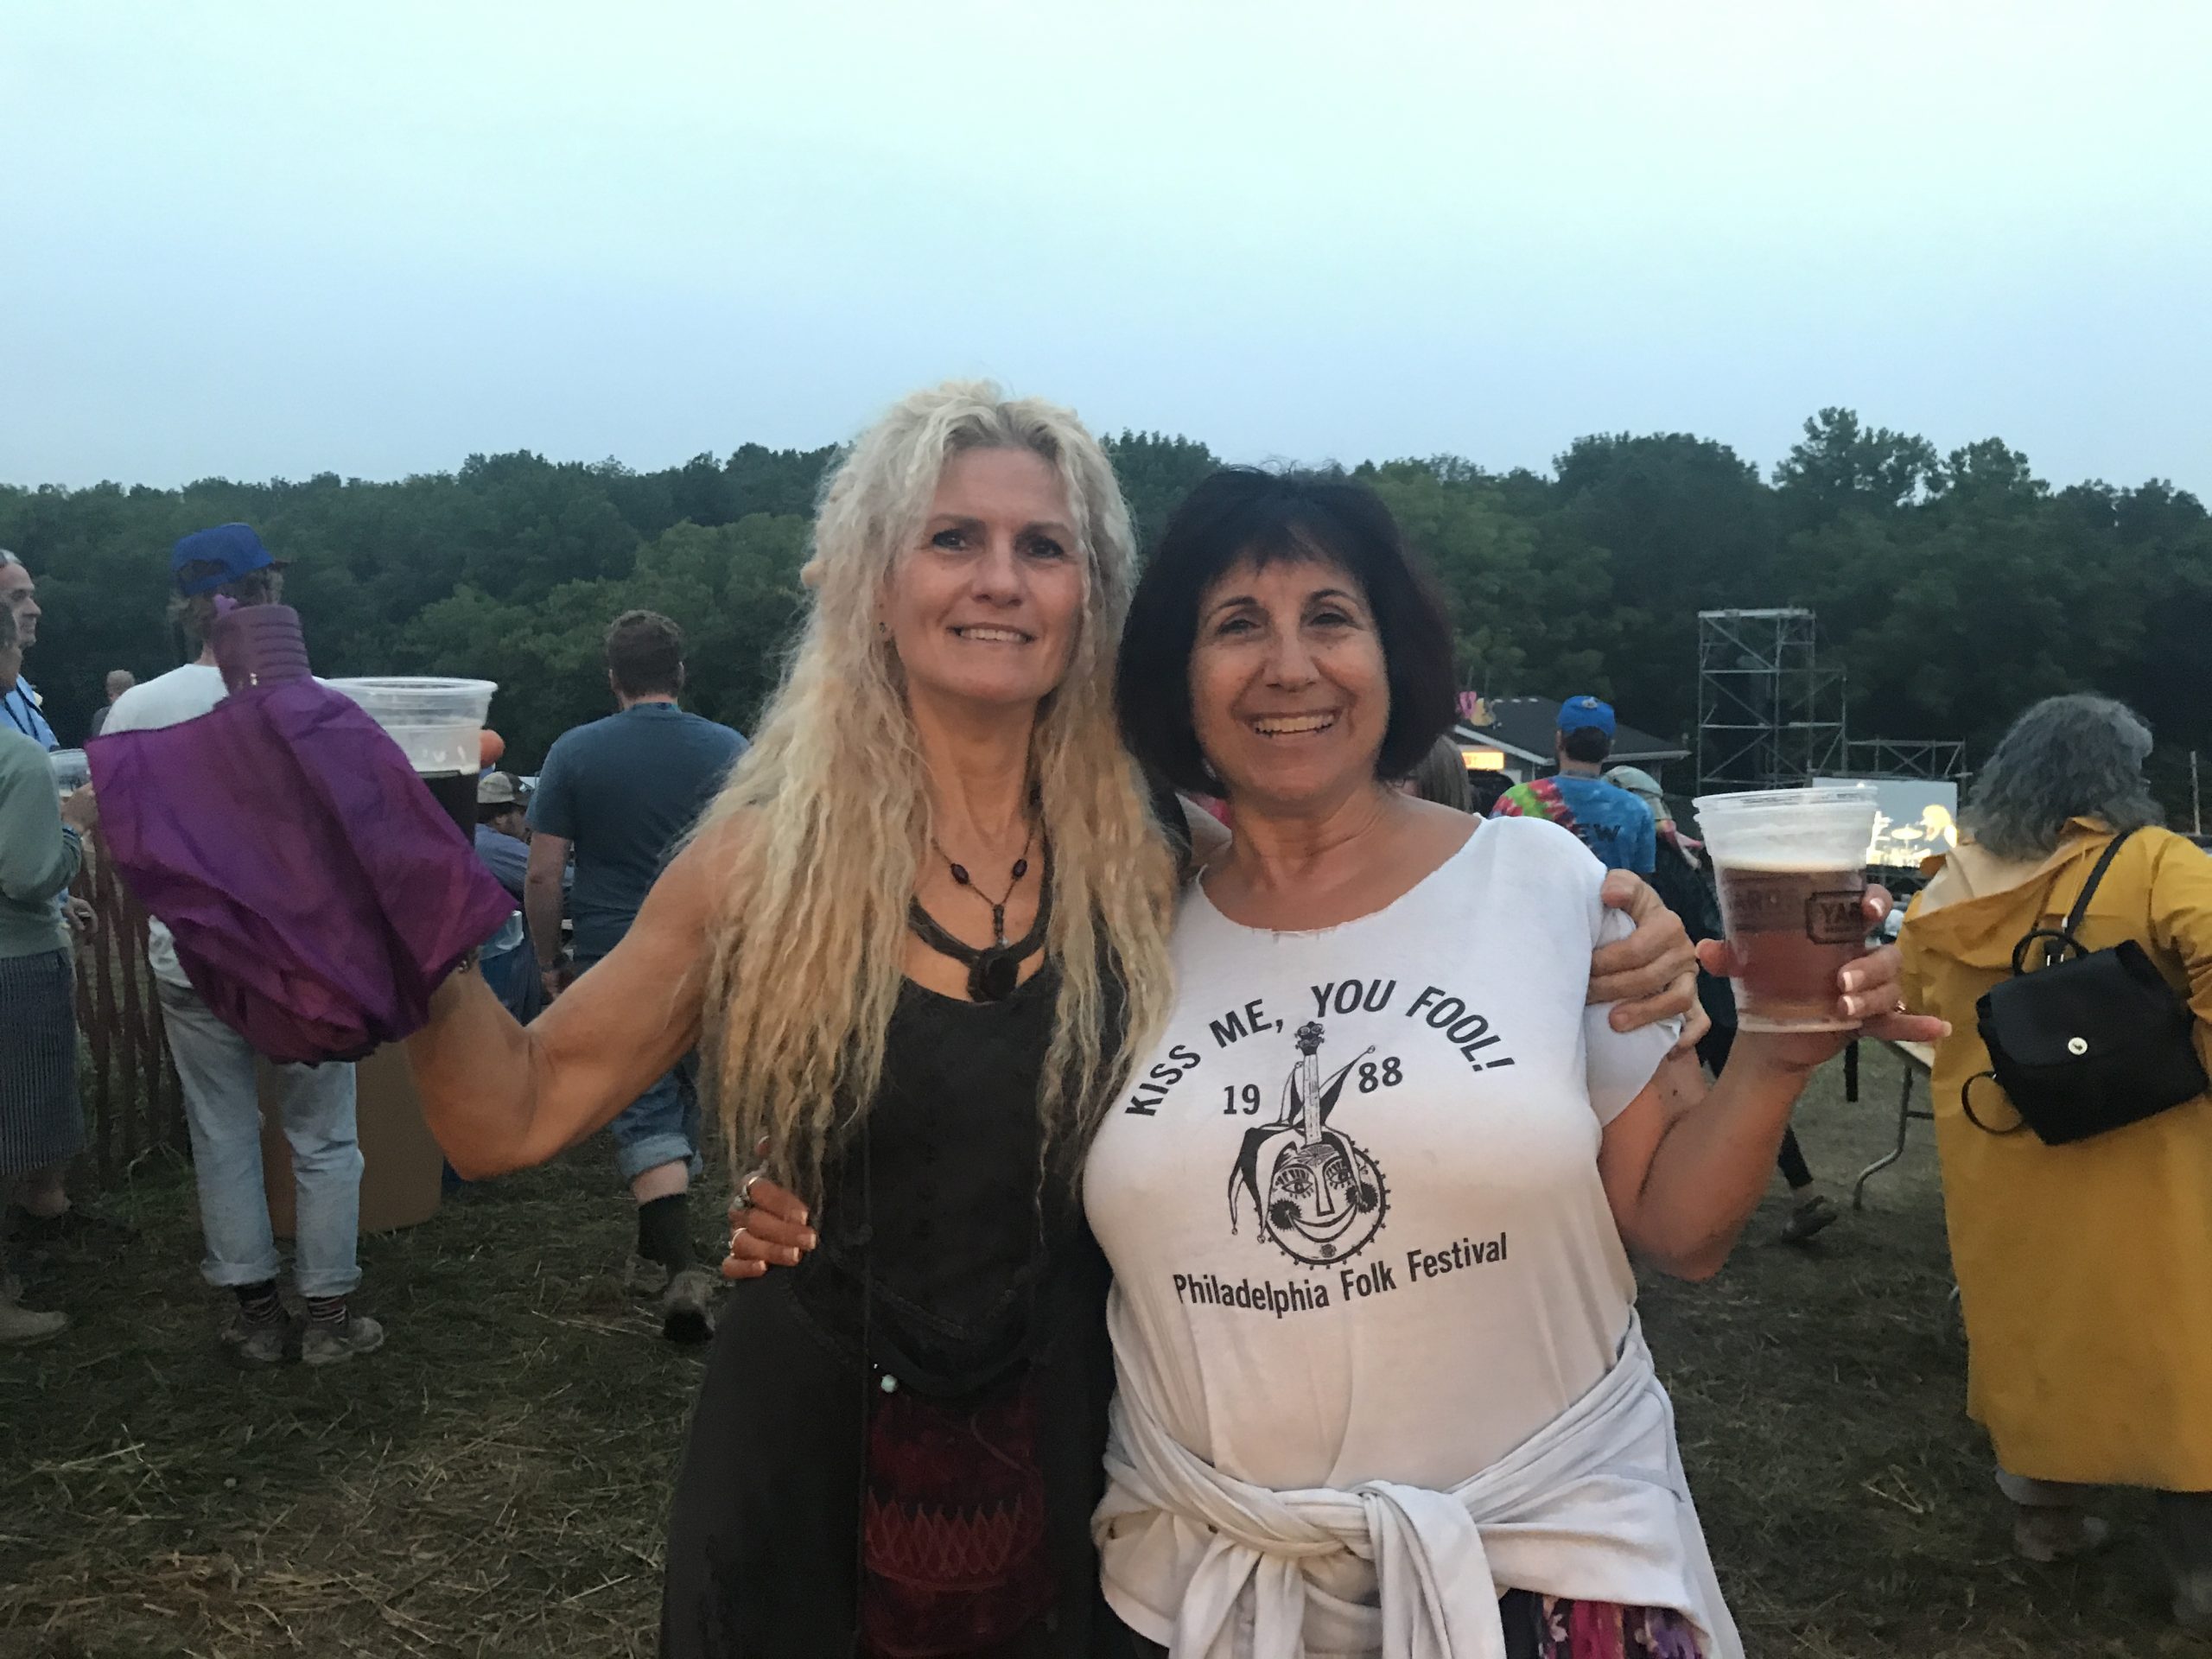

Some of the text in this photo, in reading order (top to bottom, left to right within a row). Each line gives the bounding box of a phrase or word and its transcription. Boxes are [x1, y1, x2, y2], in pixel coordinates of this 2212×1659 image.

[1124, 1044, 1202, 1117] KISS
[1208, 998, 1285, 1049] ME,
[1310, 978, 1397, 1019] YOU
[1223, 1056, 1404, 1116] 19 88
[1172, 1231, 1508, 1319] Philadelphia Folk Festival
